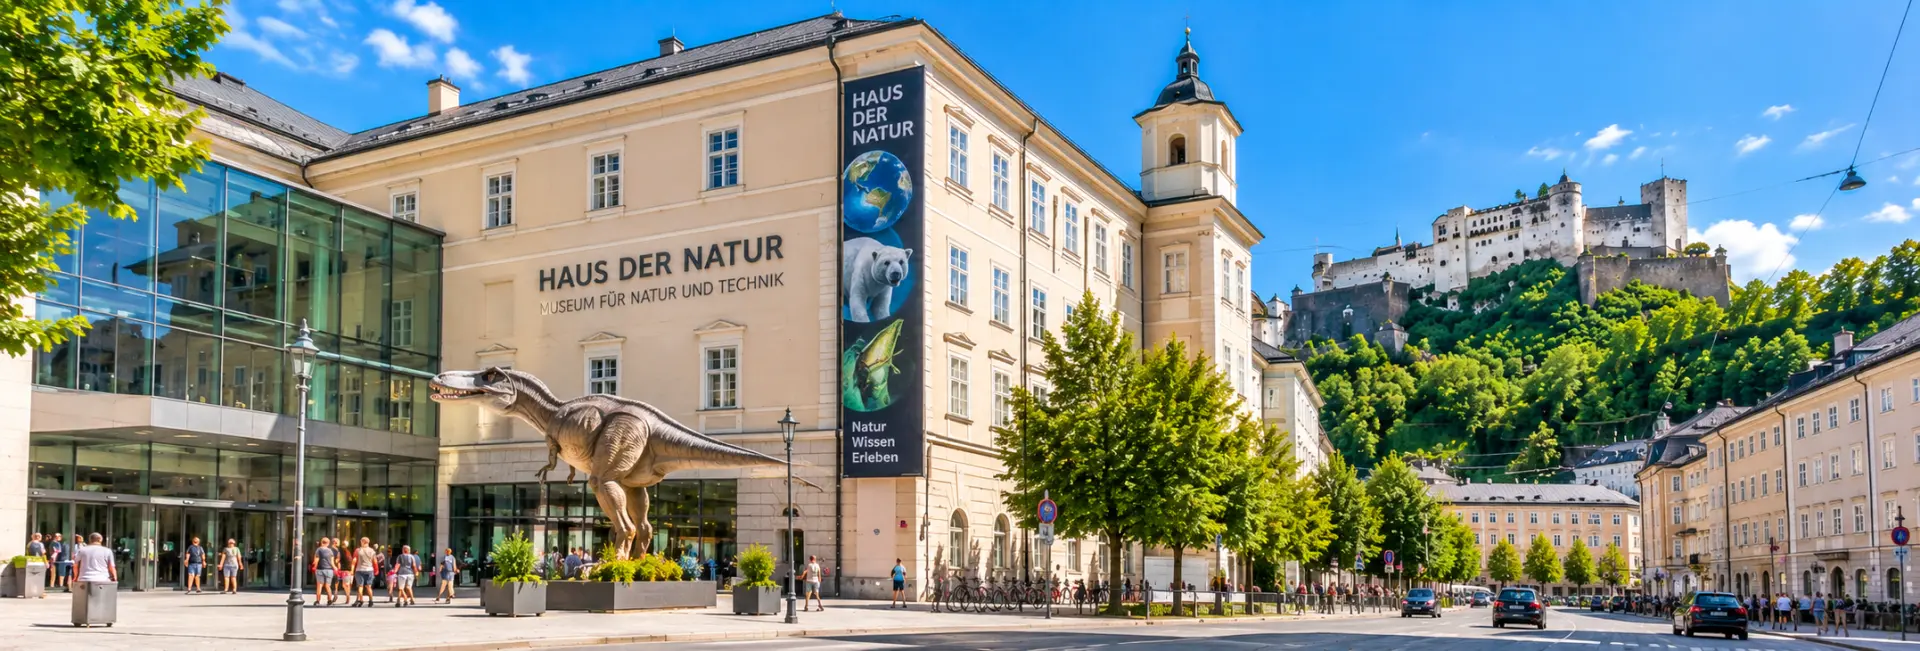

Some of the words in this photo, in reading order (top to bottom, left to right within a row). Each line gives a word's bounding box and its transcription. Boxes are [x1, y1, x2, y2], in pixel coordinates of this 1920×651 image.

[853, 84, 903, 108] HAUS
[853, 106, 888, 127] DER
[853, 120, 914, 146] NATUR
[539, 260, 608, 292] HAUS
[619, 251, 672, 281] DER
[684, 234, 784, 272] NATUR
[540, 296, 595, 315] MUSEUM
[600, 291, 626, 309] FÜR
[631, 286, 677, 305] NATUR
[682, 281, 714, 298] UND
[719, 272, 784, 294] TECHNIK
[852, 421, 886, 433] Natur
[852, 436, 895, 448] Wissen
[852, 451, 899, 463] Erleben
